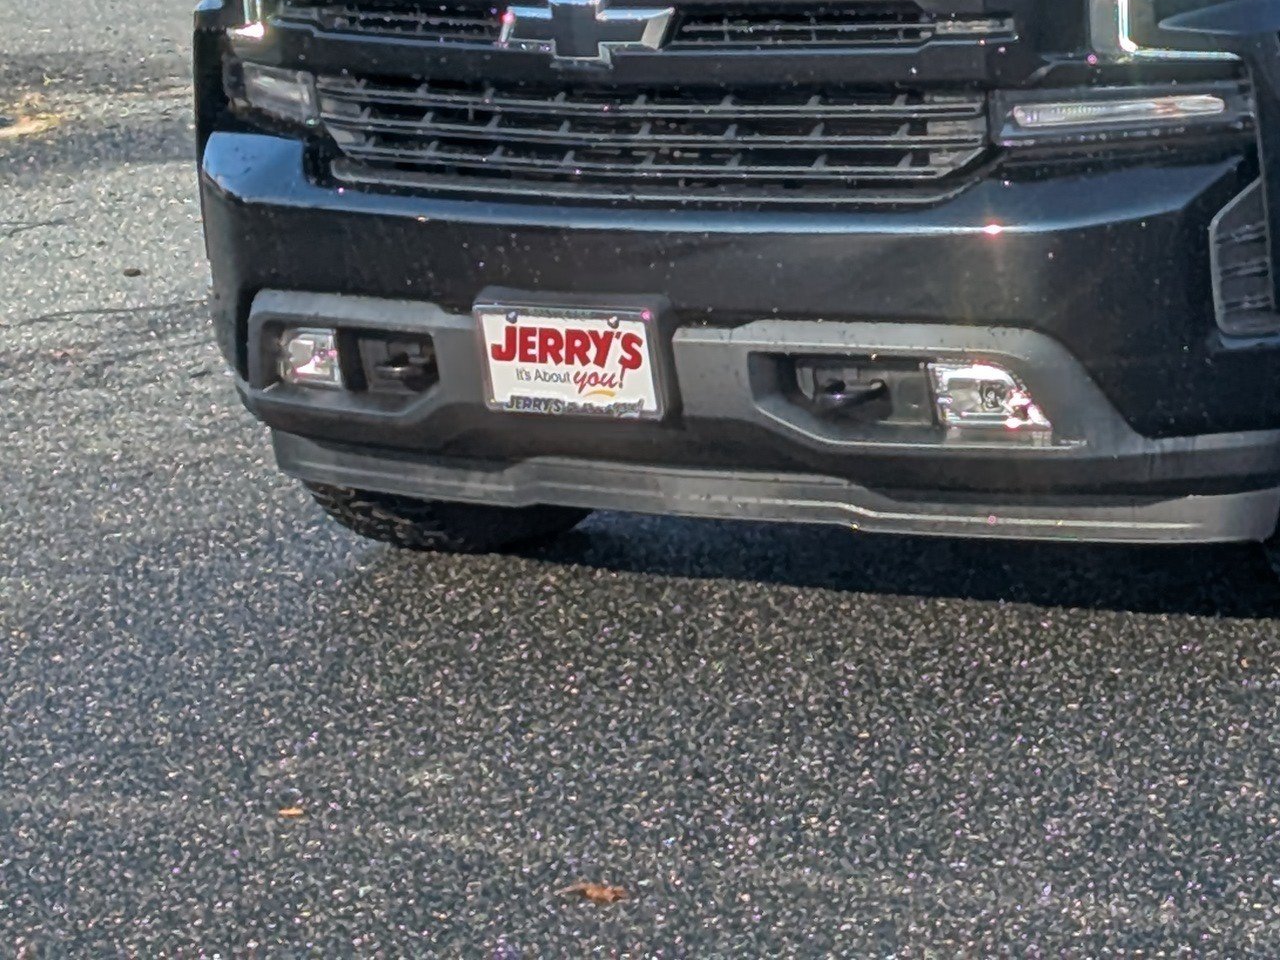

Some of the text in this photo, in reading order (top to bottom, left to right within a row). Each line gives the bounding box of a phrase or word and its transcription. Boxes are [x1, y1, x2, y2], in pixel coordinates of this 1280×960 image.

[491, 325, 643, 370] JERRY'S
[516, 368, 626, 394] It's About you!
